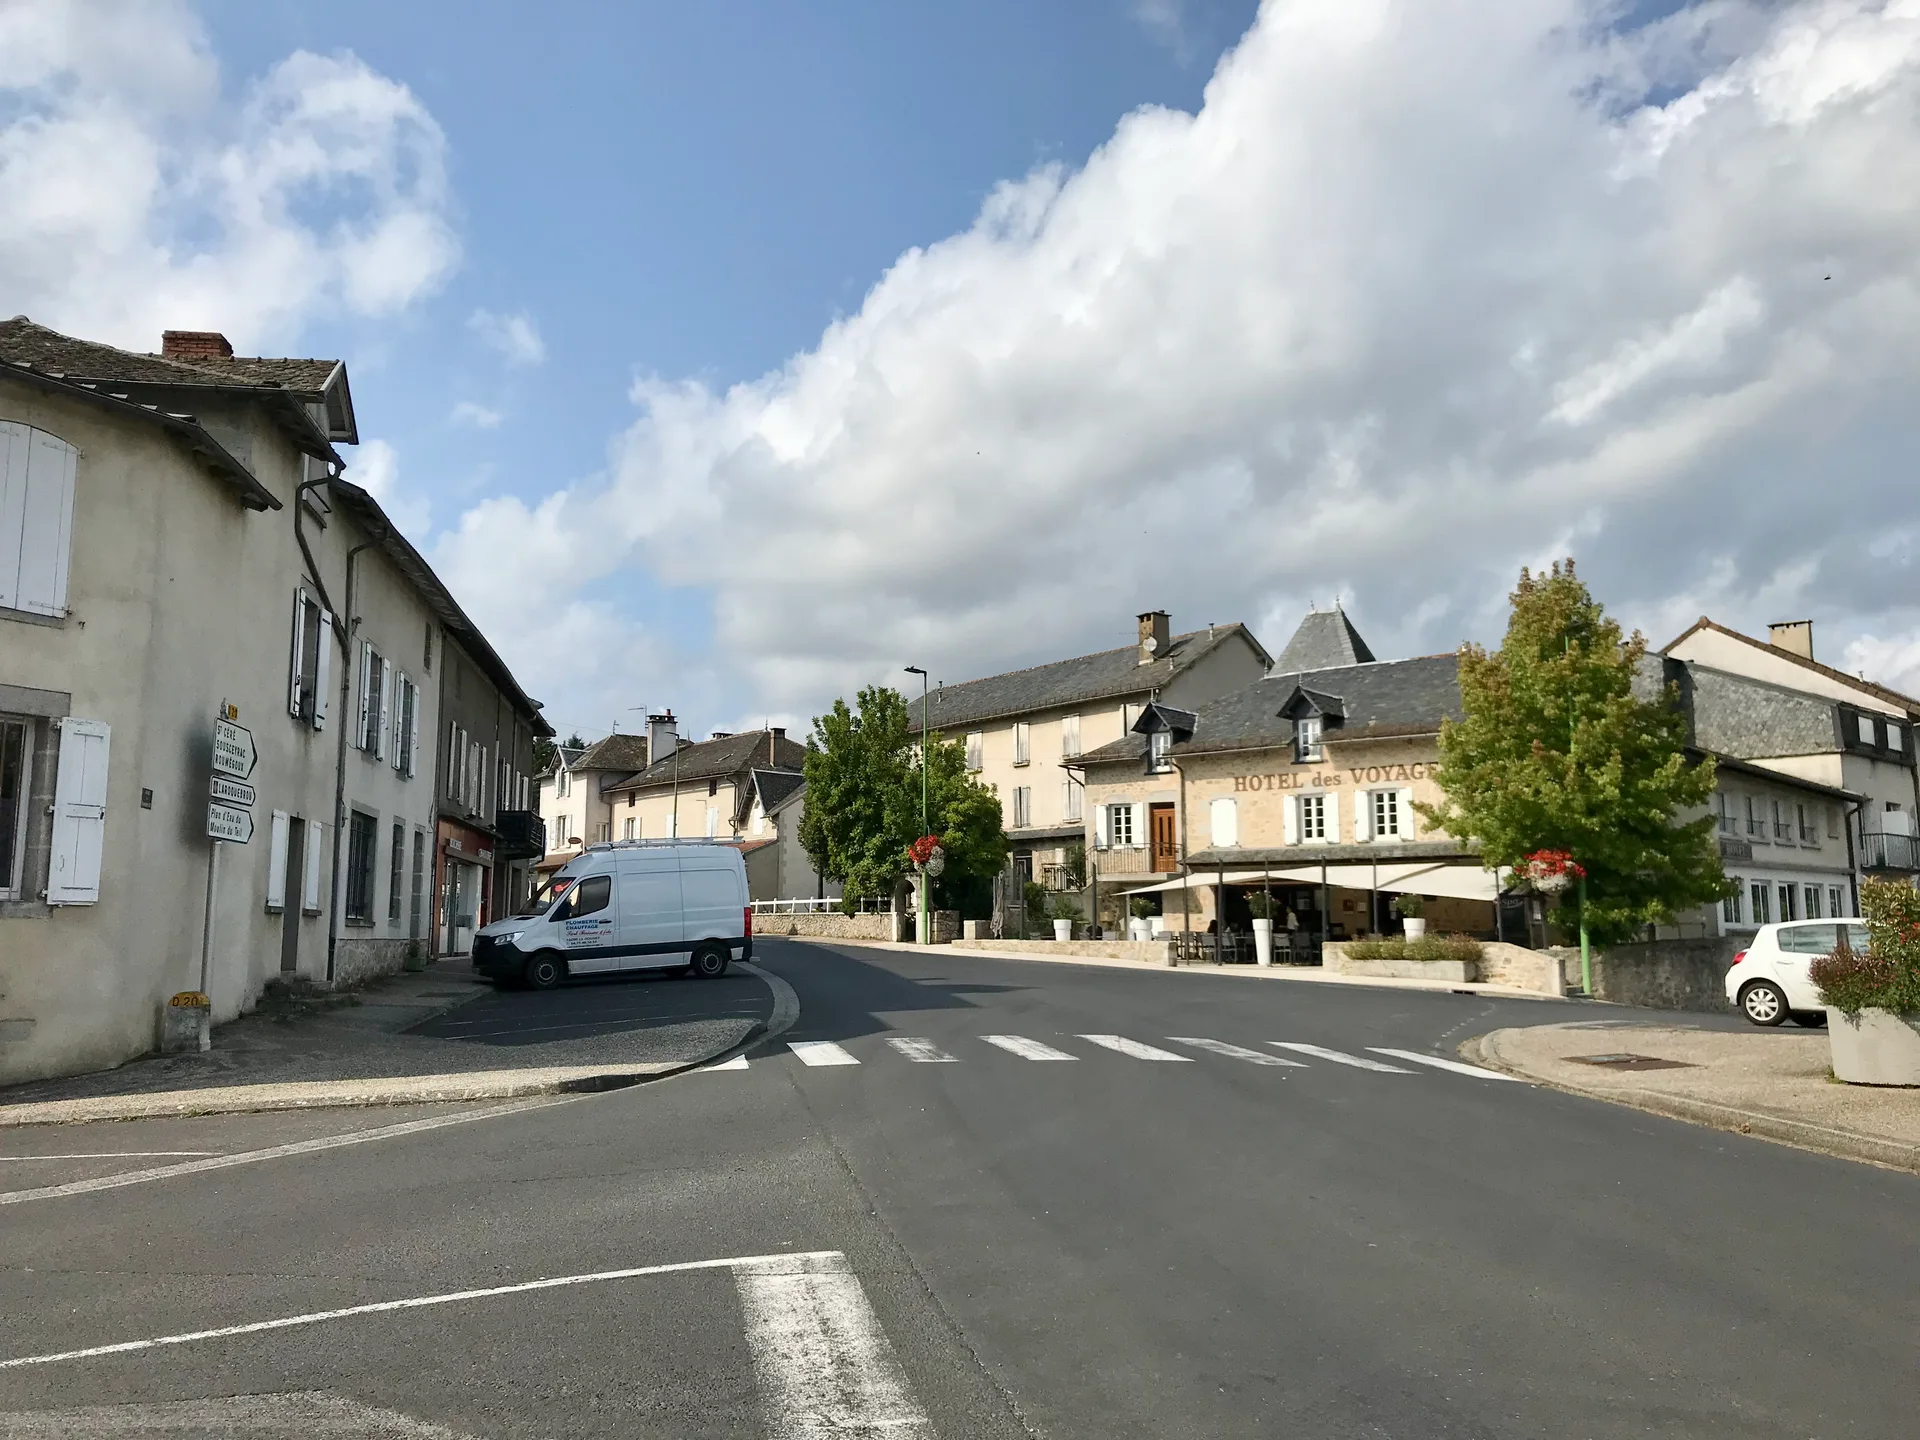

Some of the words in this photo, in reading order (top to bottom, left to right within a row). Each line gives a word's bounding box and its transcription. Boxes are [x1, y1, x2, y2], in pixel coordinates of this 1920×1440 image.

[216, 739, 246, 759] SOUSCEYRAC
[1233, 772, 1304, 793] HOTEL
[1311, 771, 1342, 788] des
[218, 783, 252, 801] LAROQUEBROU
[210, 822, 226, 834] Moulin
[172, 996, 180, 1007] D
[183, 996, 199, 1007] 20
